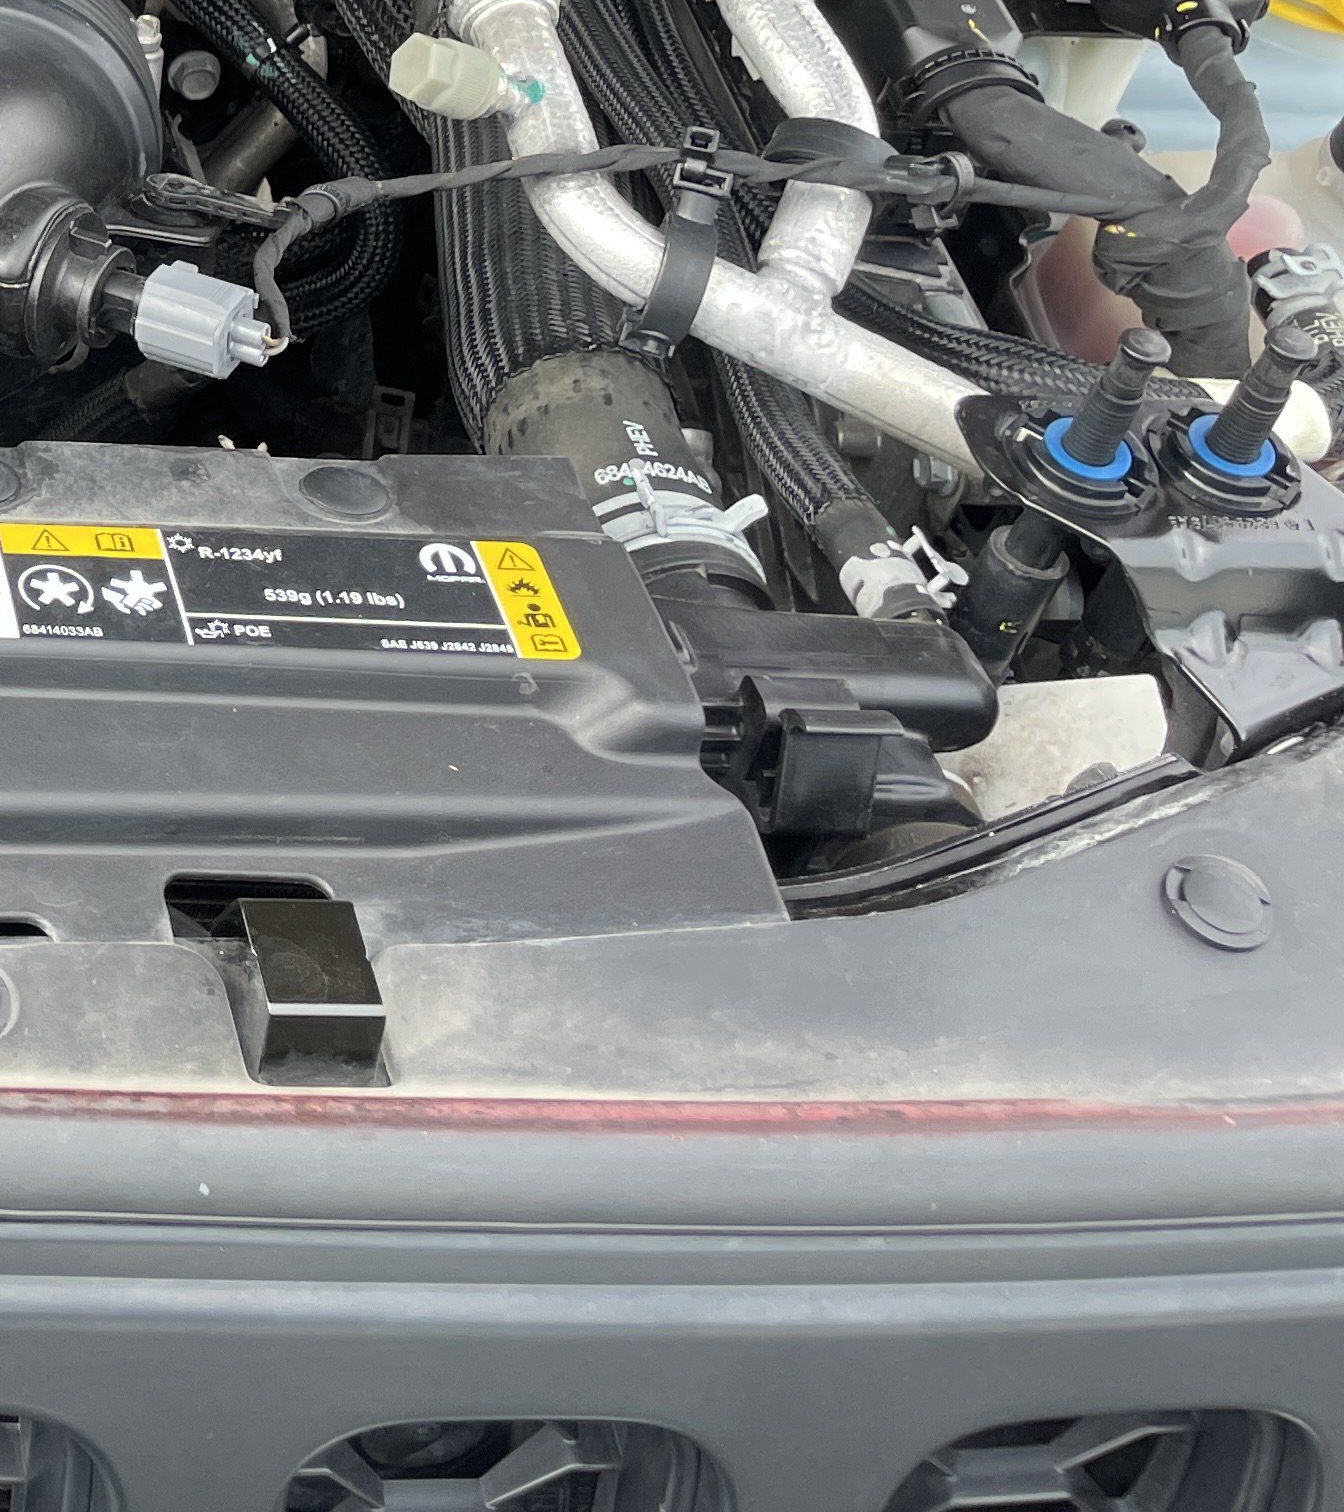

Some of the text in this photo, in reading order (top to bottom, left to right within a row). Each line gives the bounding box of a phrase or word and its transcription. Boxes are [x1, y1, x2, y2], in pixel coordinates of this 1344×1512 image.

[622, 419, 659, 457] PHEV
[197, 546, 283, 564] R-1234yf
[263, 588, 406, 610] 539g (1.19 lbs)
[232, 624, 273, 638] POE
